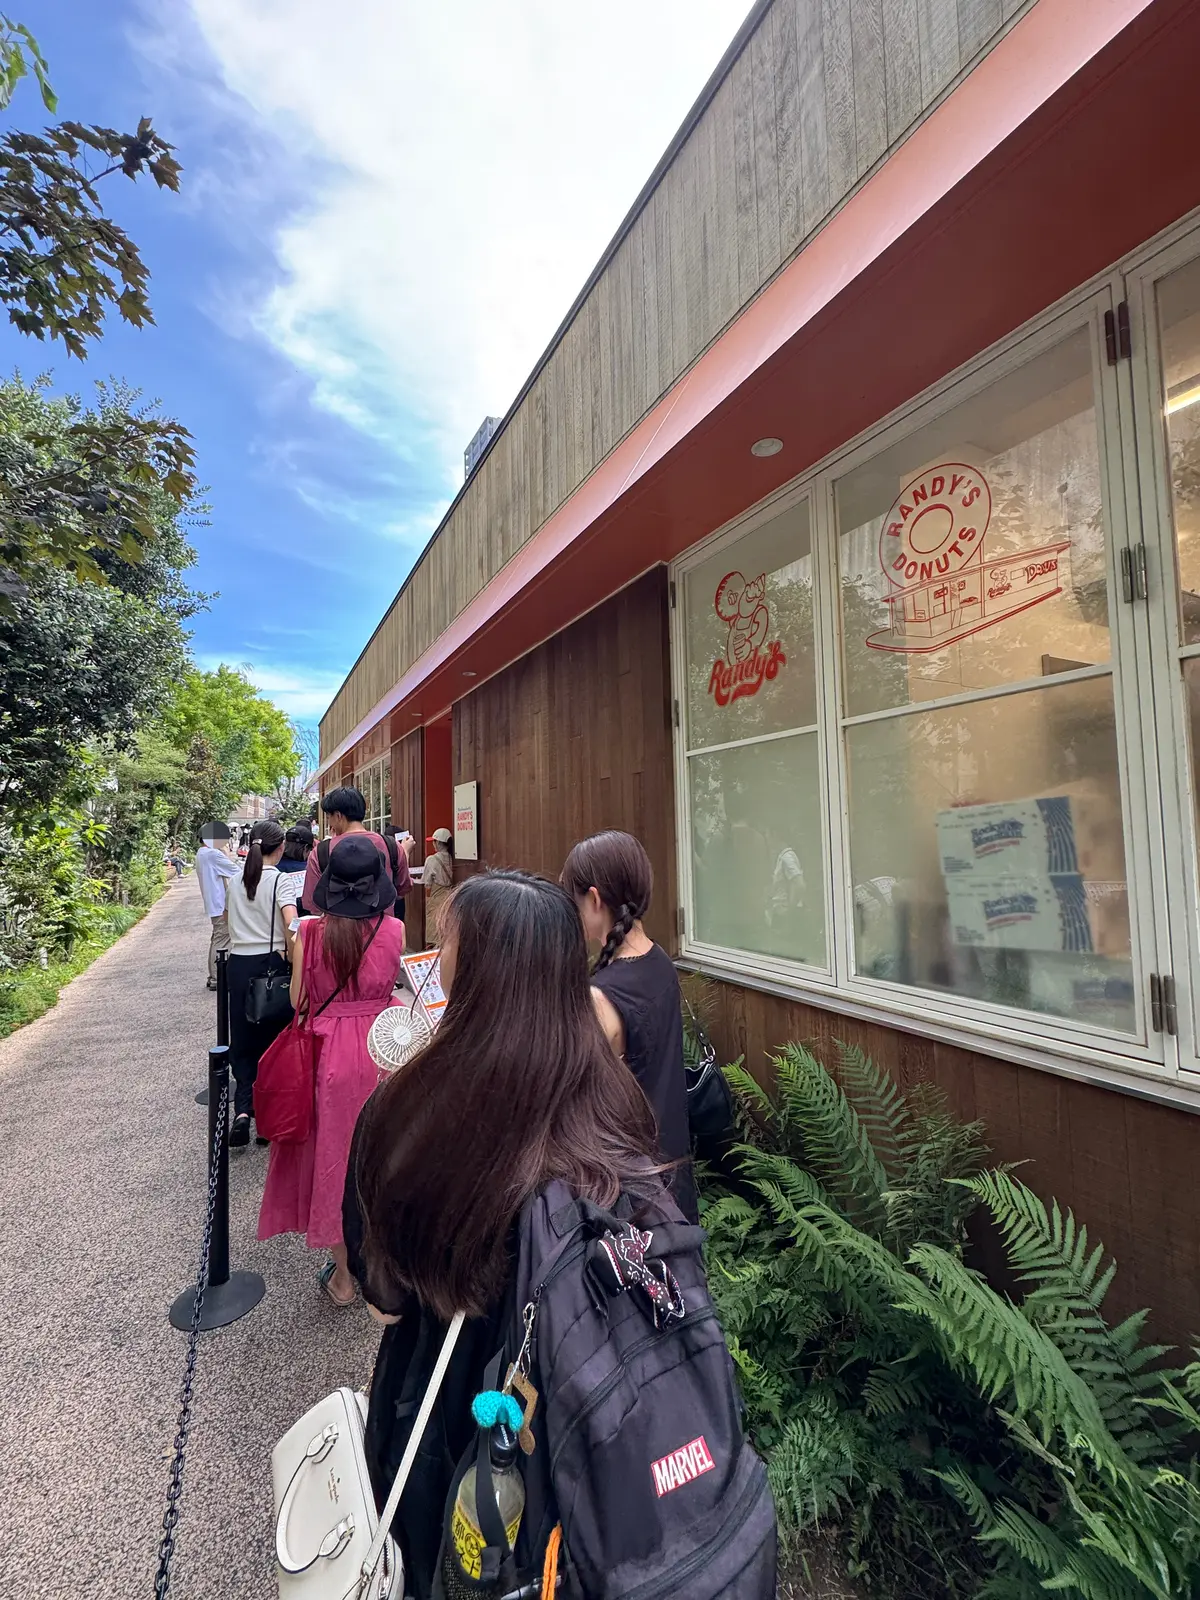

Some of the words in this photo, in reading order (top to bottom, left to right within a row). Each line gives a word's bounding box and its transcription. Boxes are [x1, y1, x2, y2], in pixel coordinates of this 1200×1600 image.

[886, 473, 981, 538] RANDY'S
[891, 526, 977, 580] DONUTS
[707, 640, 787, 707] Randy's
[457, 821, 473, 831] DONUTS
[653, 1440, 713, 1494] MARVEL
